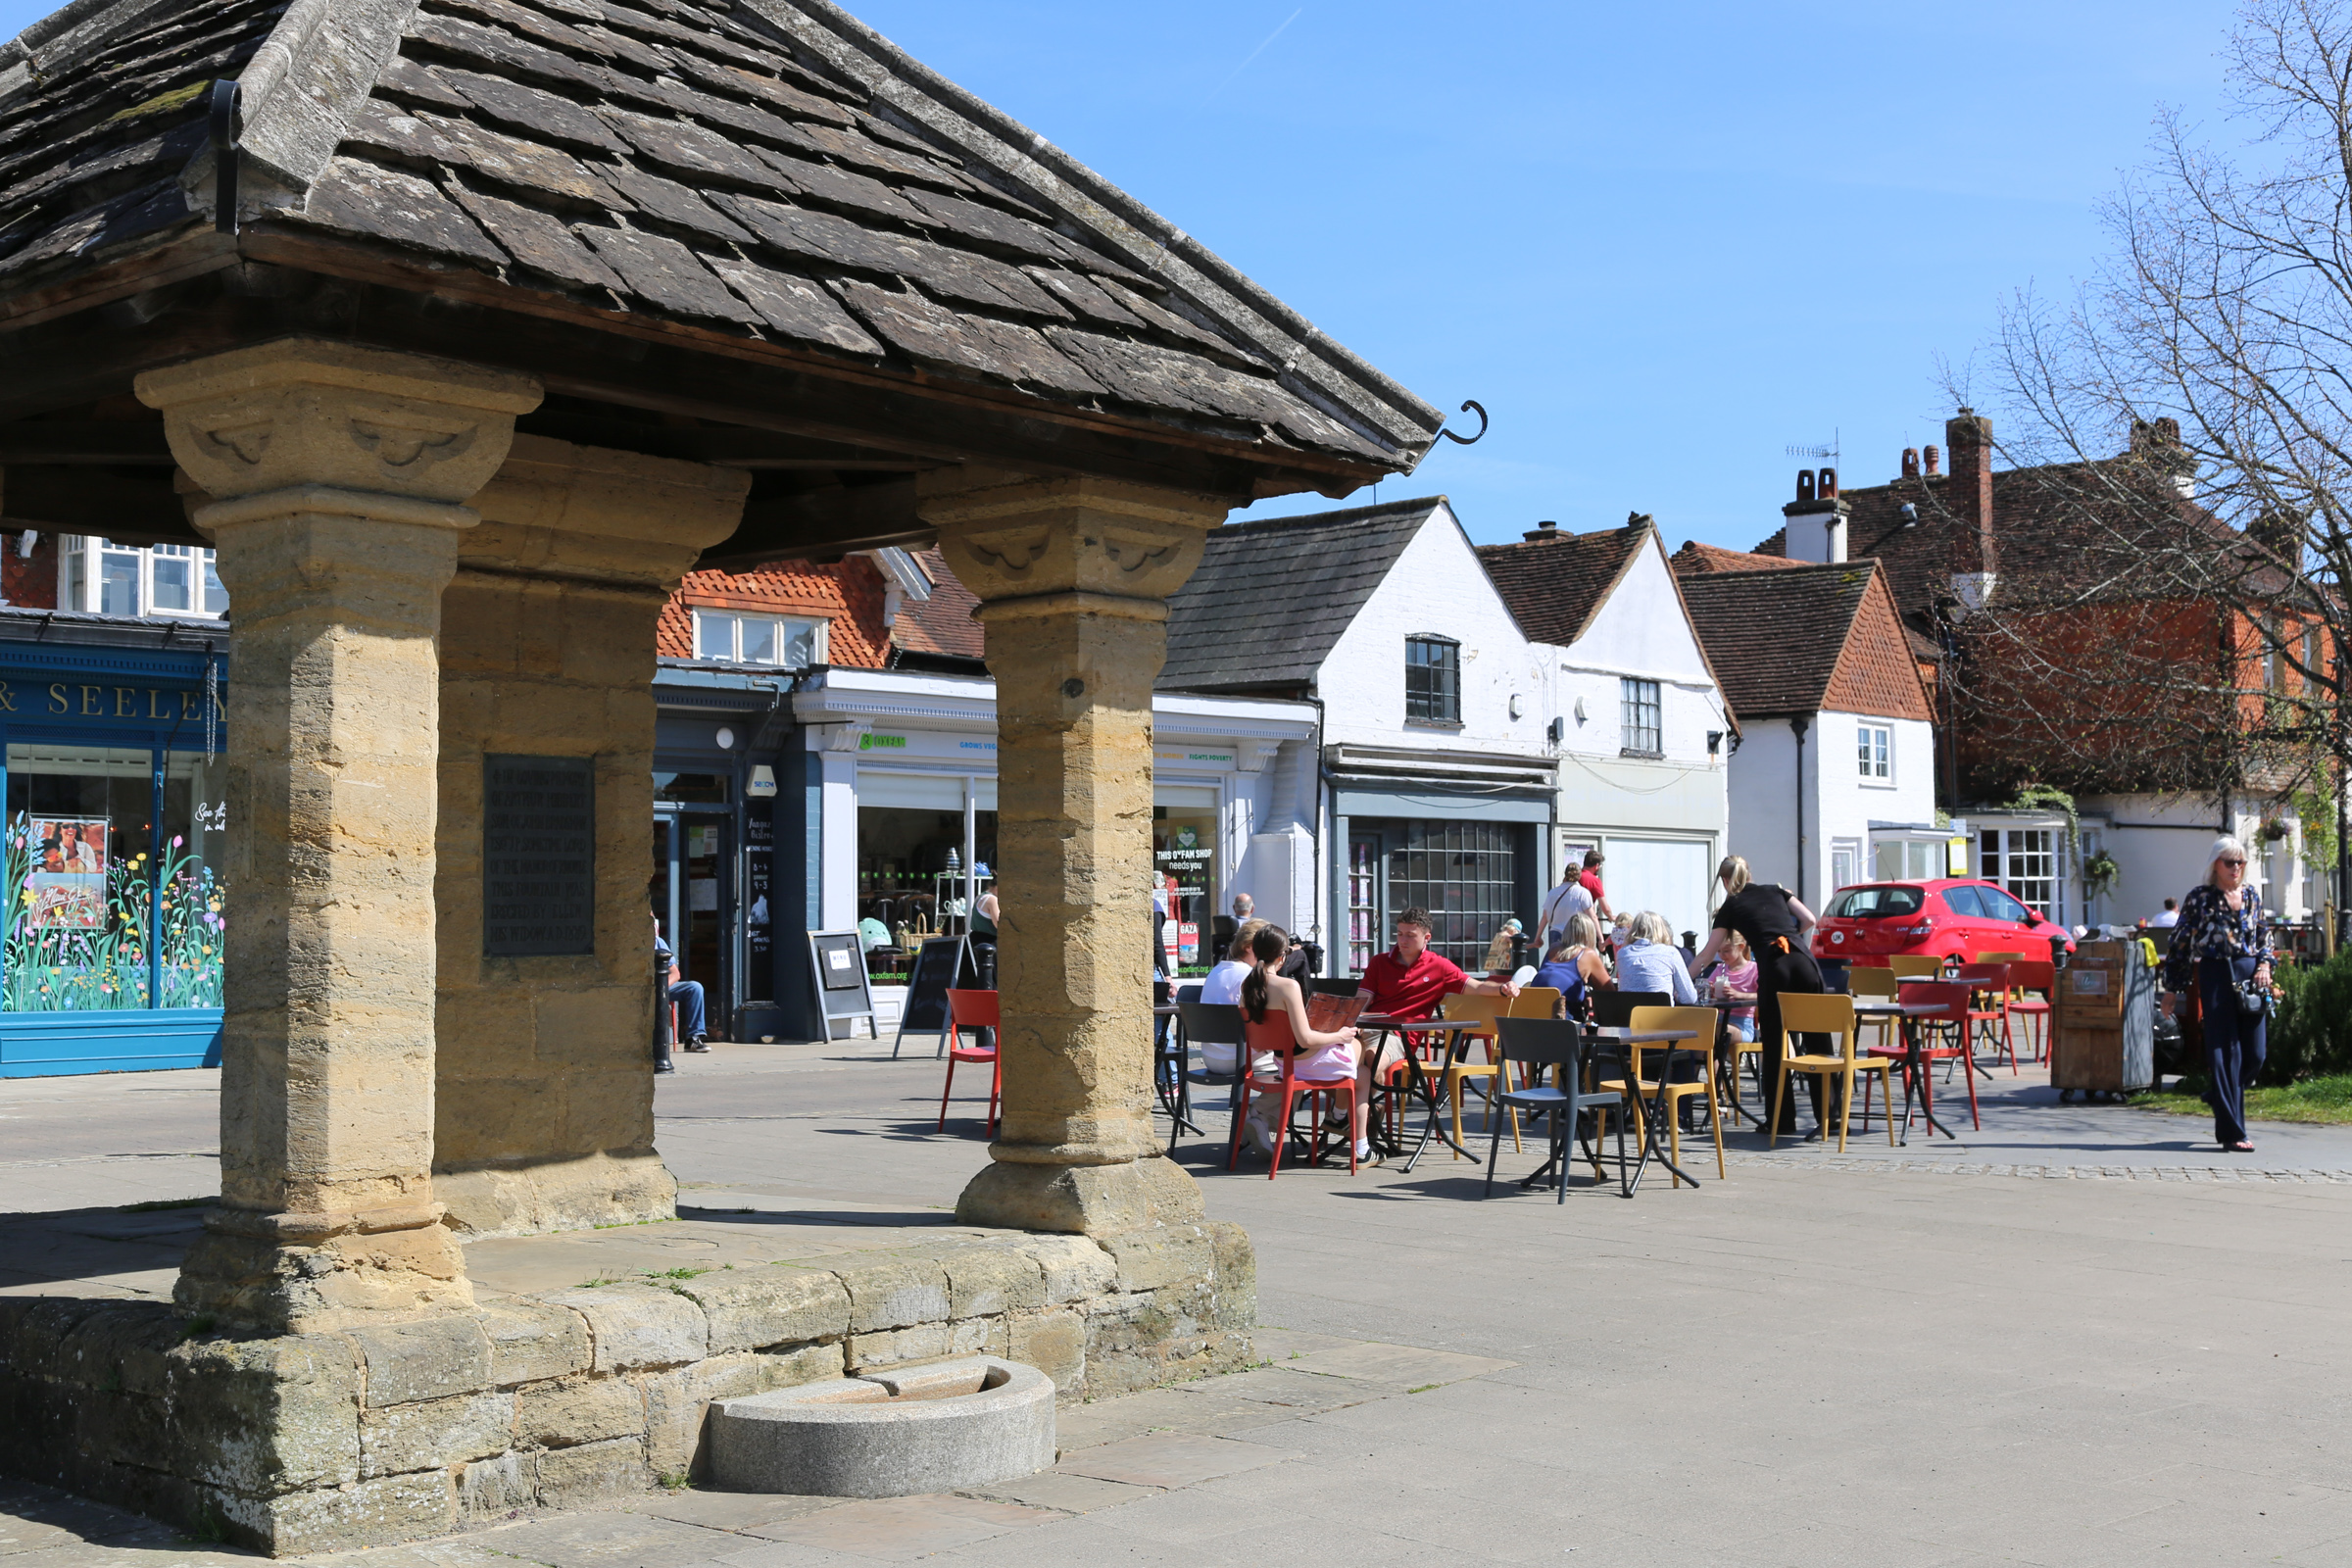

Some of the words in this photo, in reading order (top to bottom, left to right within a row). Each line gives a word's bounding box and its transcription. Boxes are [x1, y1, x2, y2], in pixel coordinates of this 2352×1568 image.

[0, 681, 19, 711] &
[874, 735, 906, 748] OXFAM
[959, 741, 982, 750] GROWS
[195, 802, 214, 821] See
[1156, 851, 1172, 860] THIS
[1196, 849, 1212, 858] SHOP
[1169, 860, 1190, 870] needs
[1190, 861, 1202, 871] you
[491, 881, 514, 897] THIS
[515, 881, 561, 897] FOUNTAIN
[564, 881, 585, 897] WAS
[533, 904, 547, 919] BY
[490, 925, 507, 942] HIS
[1180, 924, 1198, 934] GAZA
